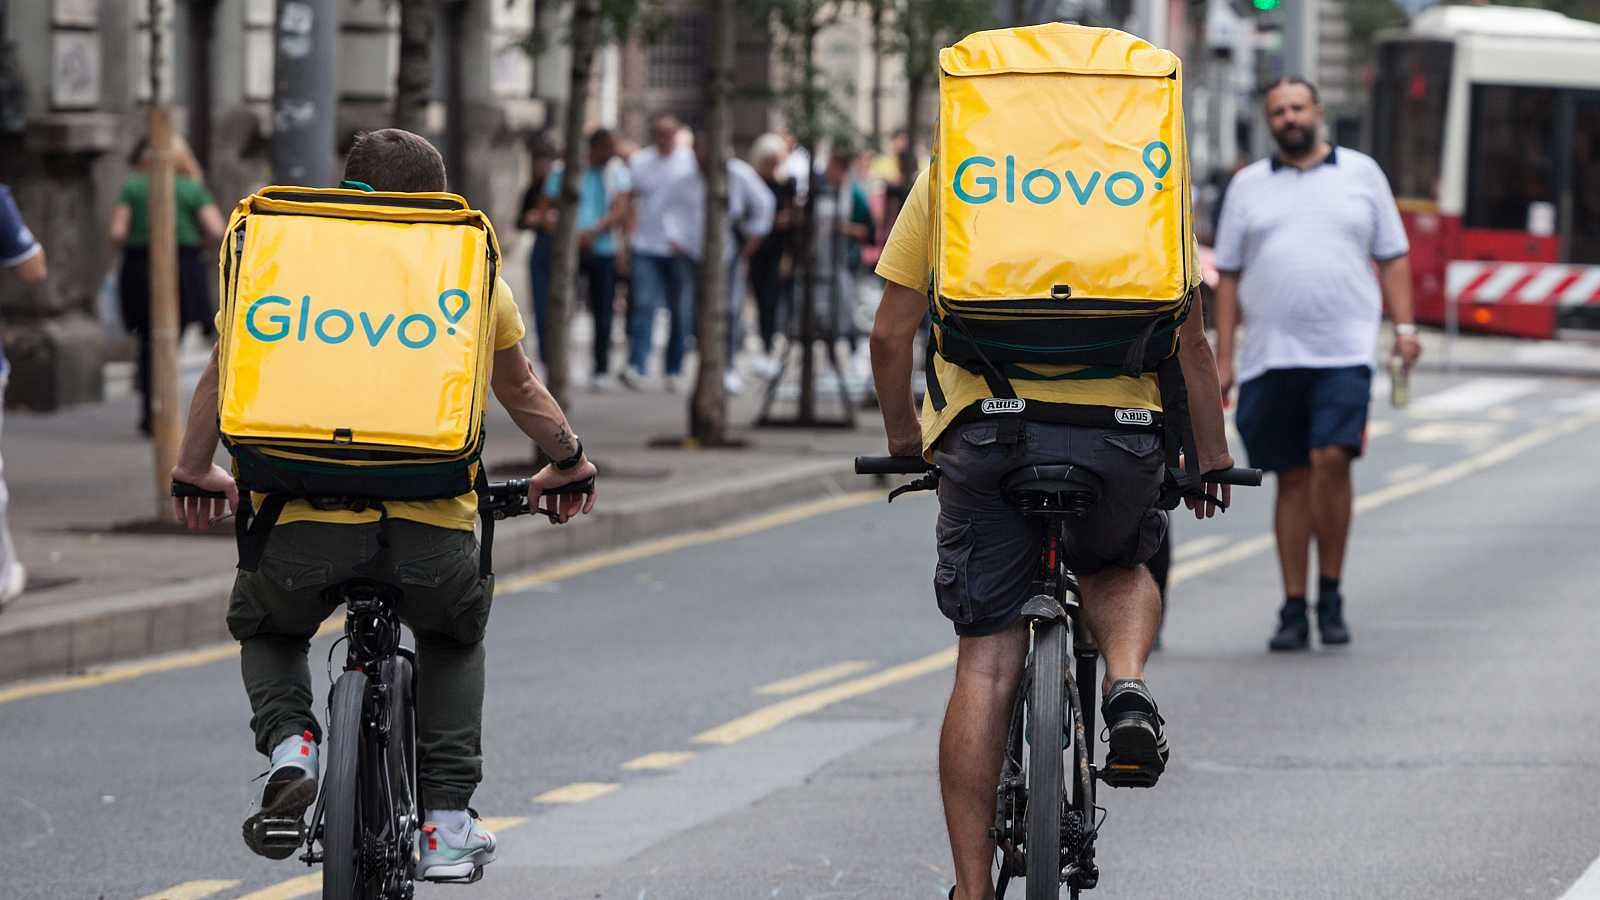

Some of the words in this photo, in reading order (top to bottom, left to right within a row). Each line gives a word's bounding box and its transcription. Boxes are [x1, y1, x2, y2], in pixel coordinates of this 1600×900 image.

[953, 156, 1145, 206] Glovo
[246, 295, 437, 349] Glovo
[986, 400, 1019, 410] ABUS
[1120, 412, 1148, 421] ABUS
